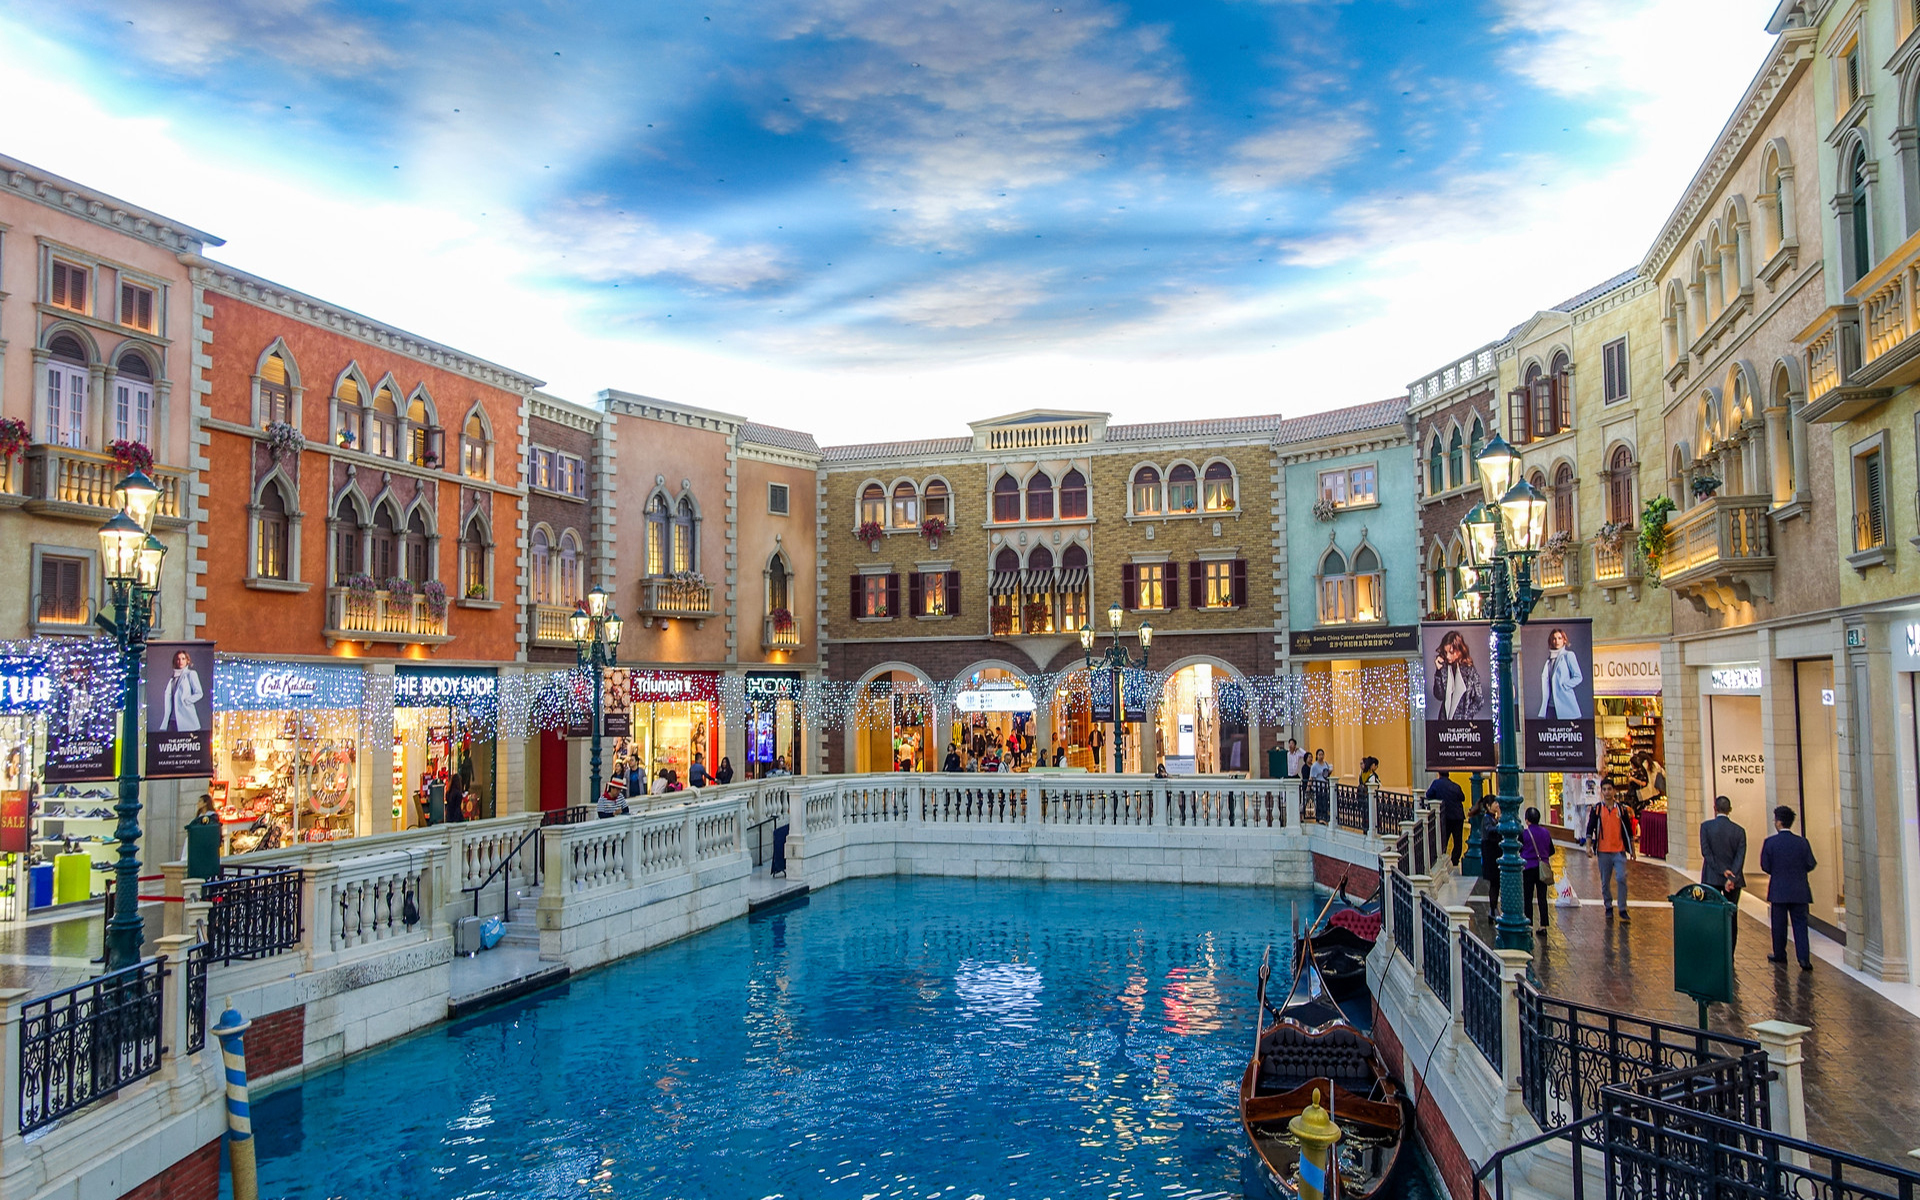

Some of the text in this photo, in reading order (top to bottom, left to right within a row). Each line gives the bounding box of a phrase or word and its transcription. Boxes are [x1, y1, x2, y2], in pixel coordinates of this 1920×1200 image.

[1313, 634, 1327, 642] Sands
[1341, 633, 1355, 641] Career
[1593, 661, 1660, 677] DI GONDOLA
[394, 677, 495, 696] THE BODY SHOP
[636, 678, 683, 697] Triumph
[748, 678, 792, 693] HOM
[1439, 732, 1481, 742] WRAPPING
[1538, 732, 1583, 742] WRAPPING
[59, 746, 103, 756] WRAPPING
[158, 742, 200, 753] WRAPPING
[1722, 754, 1764, 763] MARKS &
[319, 757, 341, 772] BAGS
[2, 816, 25, 828] SALE
